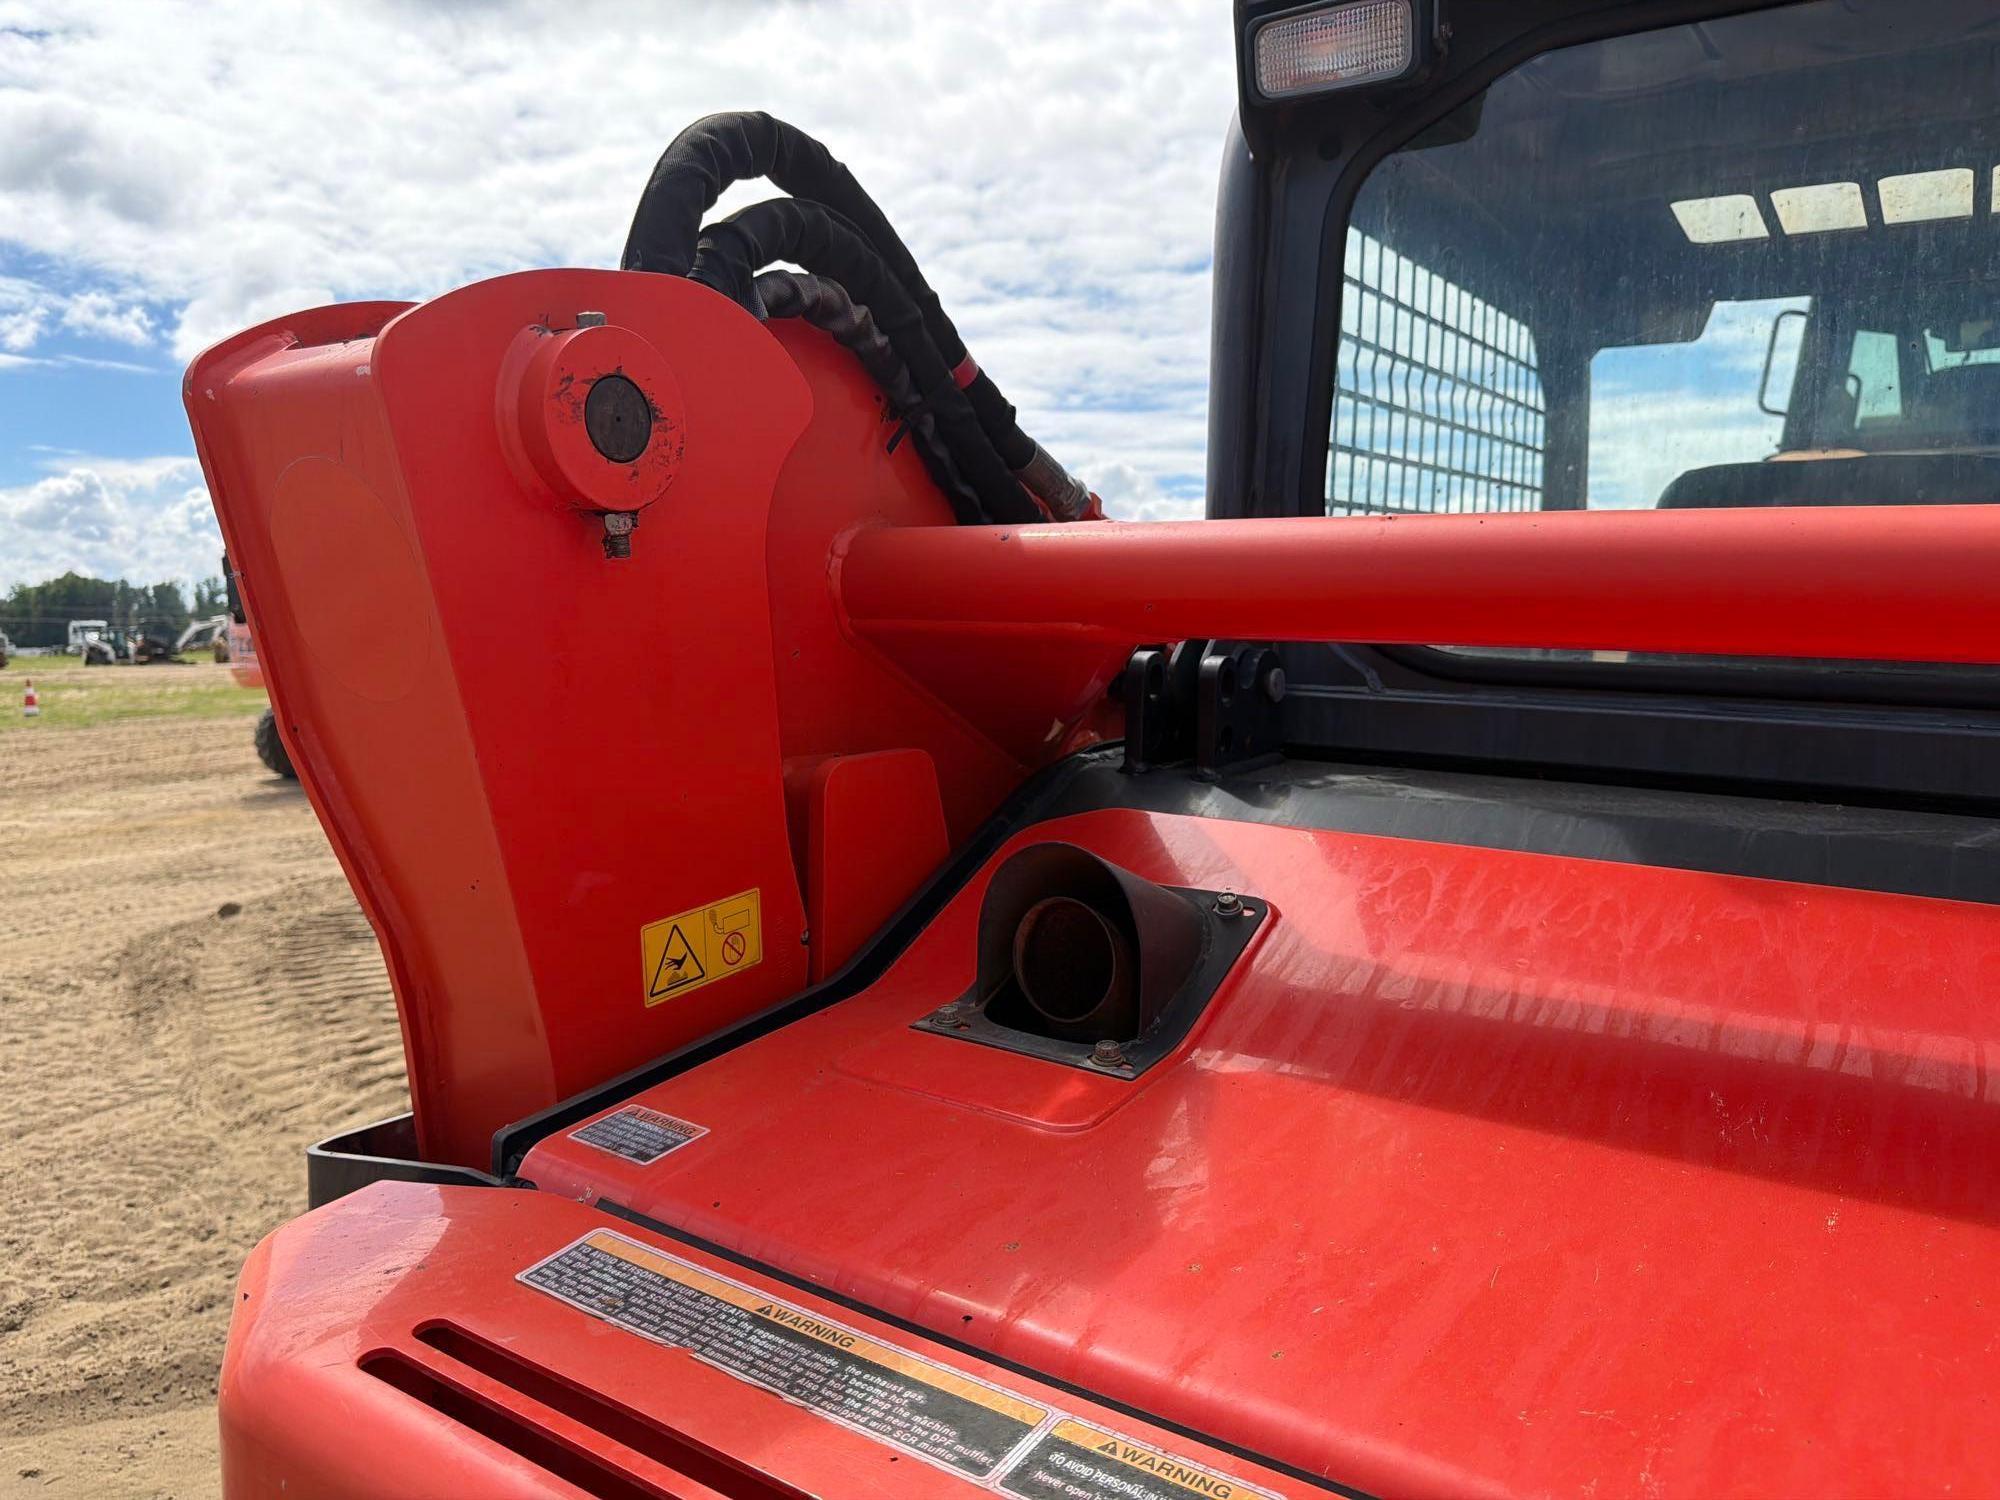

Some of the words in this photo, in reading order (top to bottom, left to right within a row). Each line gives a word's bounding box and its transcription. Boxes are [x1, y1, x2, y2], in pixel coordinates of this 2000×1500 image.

[576, 1245, 593, 1253] TO
[589, 1250, 620, 1264] AVOID
[615, 1261, 668, 1285] PERSONAL
[664, 1281, 701, 1299] INJURY
[698, 1295, 717, 1305] OR
[527, 1273, 548, 1283] and
[543, 1279, 562, 1289] the
[556, 1285, 579, 1296] SCR
[616, 1311, 643, 1325] clean
[639, 1321, 660, 1332] and
[655, 1330, 680, 1342] away
[679, 1338, 703, 1351] from
[700, 1347, 750, 1371] flammable
[819, 1399, 869, 1424] equipped
[868, 1419, 893, 1433] with
[892, 1430, 918, 1444] SCR
[917, 1440, 958, 1462] muffler
[537, 1268, 560, 1279] away
[557, 1275, 580, 1286] from
[576, 1283, 601, 1295] other
[690, 1332, 711, 1343] and
[707, 1339, 756, 1362] flammable
[795, 1377, 821, 1391] Also
[818, 1387, 846, 1402] keep
[843, 1397, 863, 1409] the
[860, 1406, 884, 1418] area
[885, 1416, 909, 1429] near
[909, 1425, 930, 1437] the
[928, 1433, 955, 1448] DPF
[546, 1261, 579, 1276] During
[627, 1295, 649, 1306] take
[646, 1303, 667, 1314] into
[663, 1310, 700, 1328] account
[698, 1325, 720, 1336] that
[716, 1332, 736, 1343] the
[732, 1339, 773, 1359] mufflers
[771, 1355, 792, 1366] will
[790, 1363, 806, 1373] be
[802, 1370, 827, 1383] very
[826, 1379, 847, 1390] hot
[844, 1386, 867, 1399] and
[864, 1395, 893, 1411] keep
[892, 1406, 912, 1418] the
[557, 1256, 576, 1265] the
[570, 1261, 593, 1272] DPF
[587, 1268, 620, 1284] muffler
[615, 1280, 636, 1290] and
[631, 1286, 651, 1297] the
[796, 1356, 835, 1375] muffler
[848, 1377, 890, 1398] become
[589, 1260, 606, 1268] the
[627, 1275, 674, 1297] Particulate
[716, 1312, 729, 1320] is
[725, 1316, 740, 1324] in
[736, 1321, 755, 1331] the
[751, 1327, 813, 1356] regenerating
[843, 1365, 864, 1376] the
[861, 1373, 904, 1393] exhaust
[773, 1309, 856, 1348] WARNING
[1033, 1470, 1066, 1488] Never
[1065, 1485, 1093, 1500] open
[1064, 1460, 1094, 1477] AVOID
[1092, 1470, 1146, 1498] PERSONAL
[1122, 1447, 1232, 1499] WARNING
